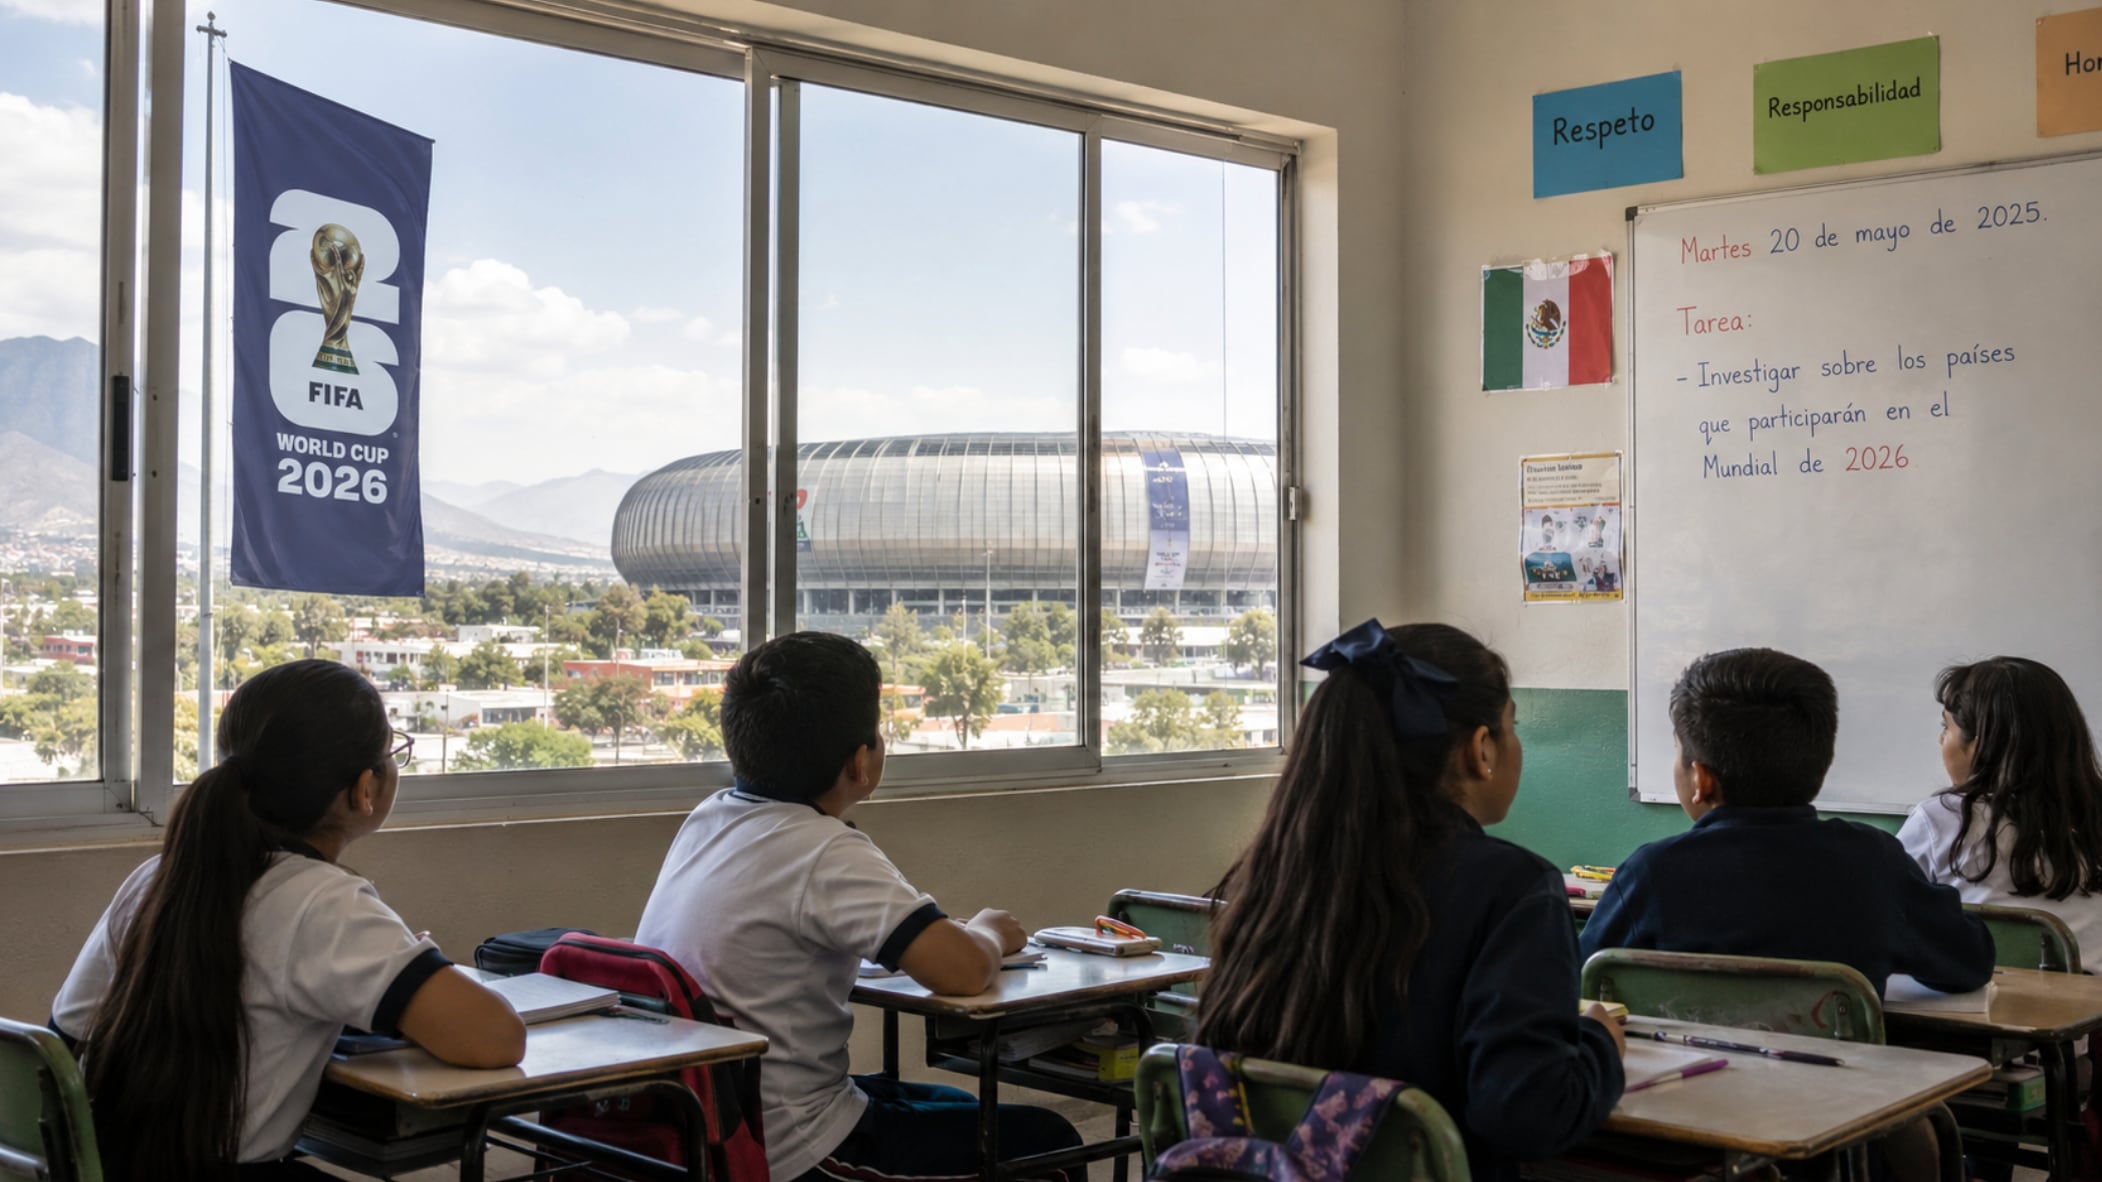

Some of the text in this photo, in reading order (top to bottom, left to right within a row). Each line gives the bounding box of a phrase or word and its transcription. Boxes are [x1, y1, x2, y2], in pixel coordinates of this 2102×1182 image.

[1768, 75, 1921, 123] Responsabilidad
[1553, 106, 1655, 150] Respeto
[1680, 200, 2048, 264] Martes 20 de mayo de 2025.
[1676, 305, 1753, 337] Tarea:
[1697, 357, 1801, 394] Investigar
[1820, 349, 1878, 377] sobre
[1897, 343, 1927, 371] los
[1946, 343, 2016, 379] países
[308, 380, 364, 411] FIFA
[1698, 390, 1950, 446] que participarán en el
[276, 432, 389, 465] WORLD CUP
[1703, 444, 1910, 479] Mundial de 2026
[277, 457, 389, 505] 2026
